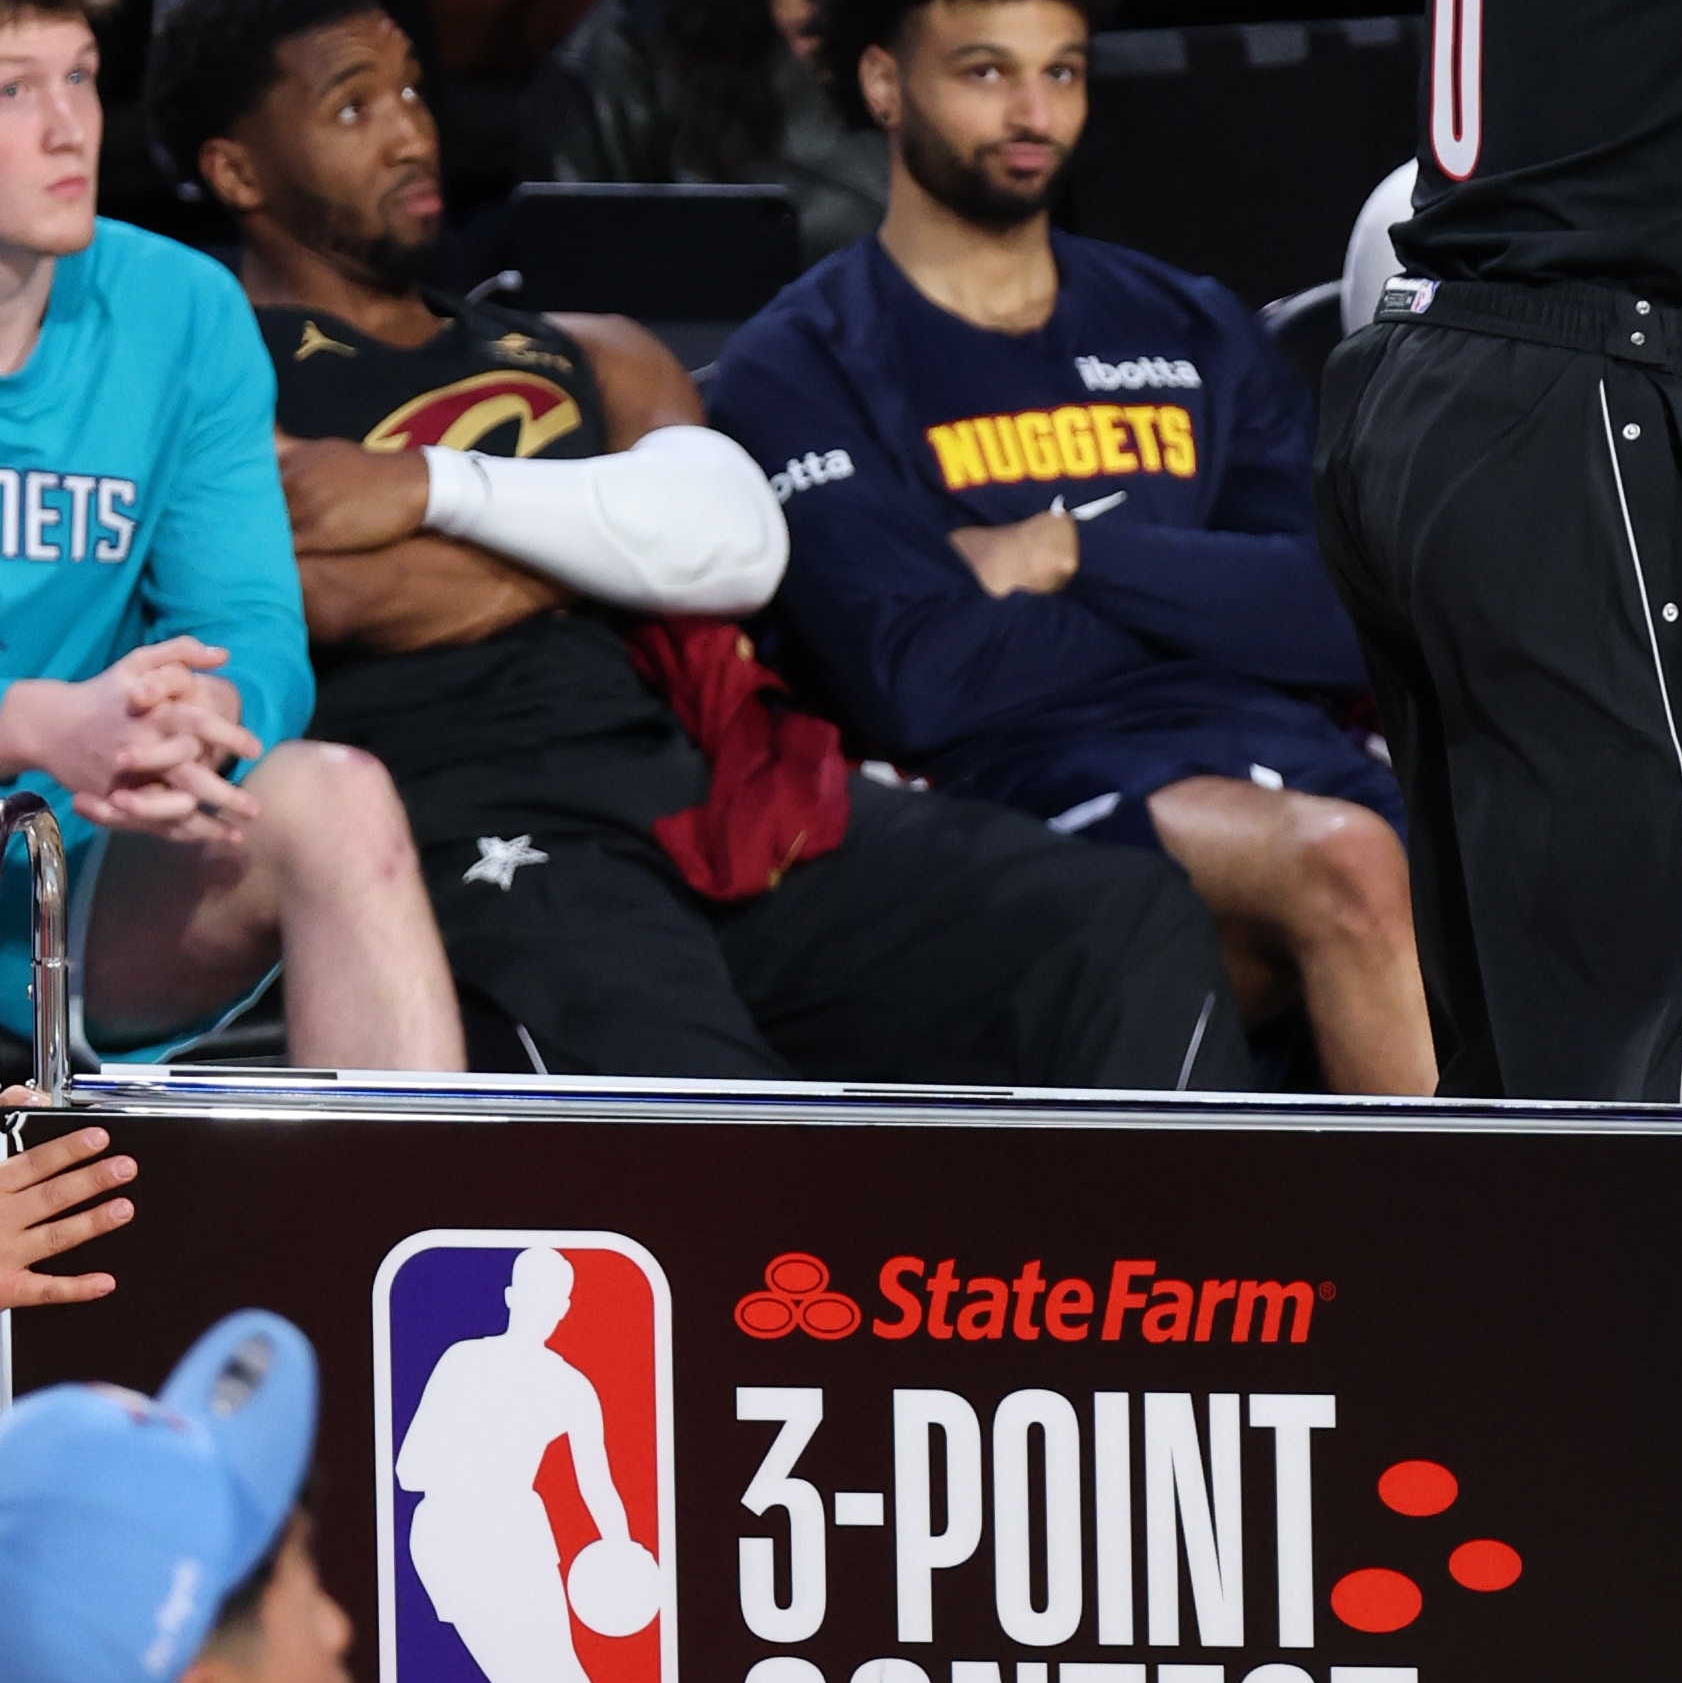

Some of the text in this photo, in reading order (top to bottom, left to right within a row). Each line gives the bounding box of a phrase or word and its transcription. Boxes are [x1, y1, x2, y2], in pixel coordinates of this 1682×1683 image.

[1073, 354, 1203, 392] ibotta
[926, 401, 1198, 493] NUGGETS
[735, 1386, 1337, 1649] 3-POINT
